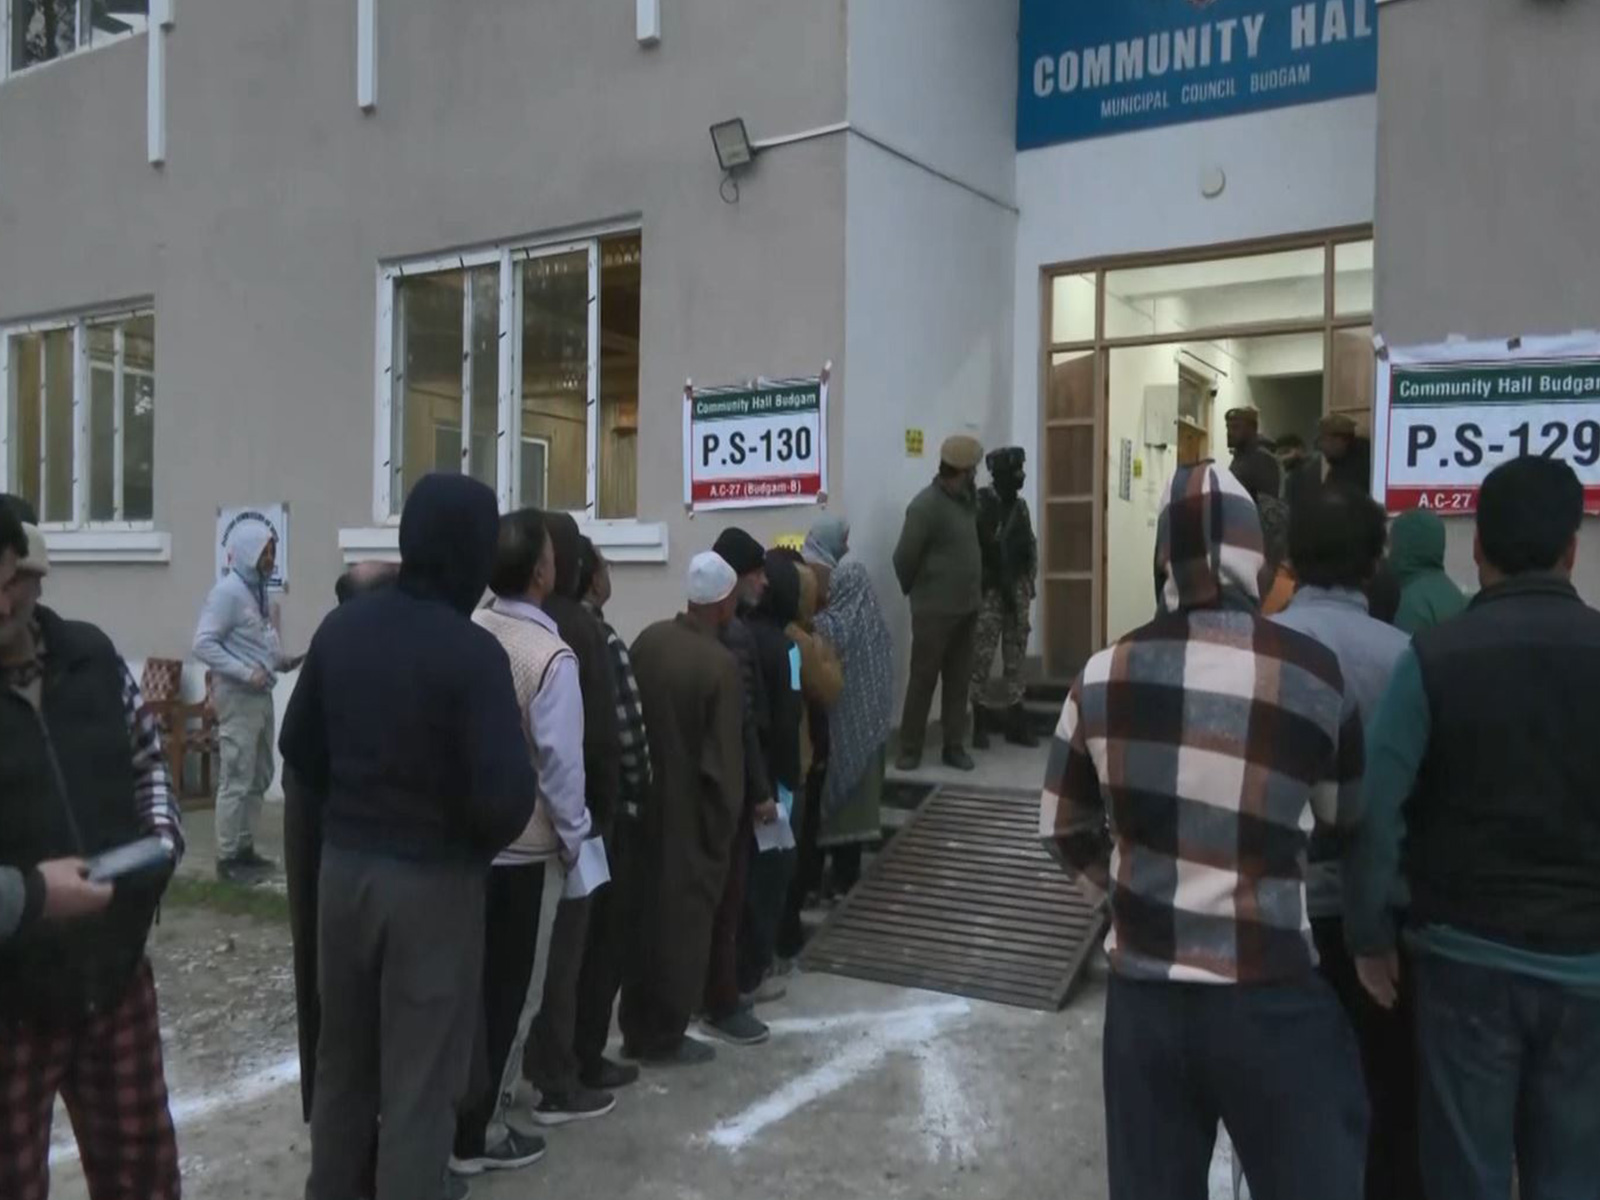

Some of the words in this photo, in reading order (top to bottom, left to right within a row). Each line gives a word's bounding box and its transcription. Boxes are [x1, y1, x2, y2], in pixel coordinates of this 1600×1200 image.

[1033, 12, 1265, 97] COMMUNITY
[1290, 0, 1372, 50] HAL
[1101, 90, 1170, 118] MUNICIPAL
[1181, 77, 1236, 104] COUNCIL
[1250, 63, 1311, 94] BUDGAM
[1400, 379, 1492, 398] Community
[1498, 376, 1532, 393] Hall
[696, 398, 748, 414] Community
[752, 395, 772, 409] Hall
[775, 393, 816, 407] Budgam
[702, 426, 811, 467] P.S-130
[1407, 419, 1600, 468] P.S-129
[710, 484, 741, 497] A.C-27
[743, 480, 801, 498] (Budgam-B)
[1418, 492, 1472, 509] A.C-27
